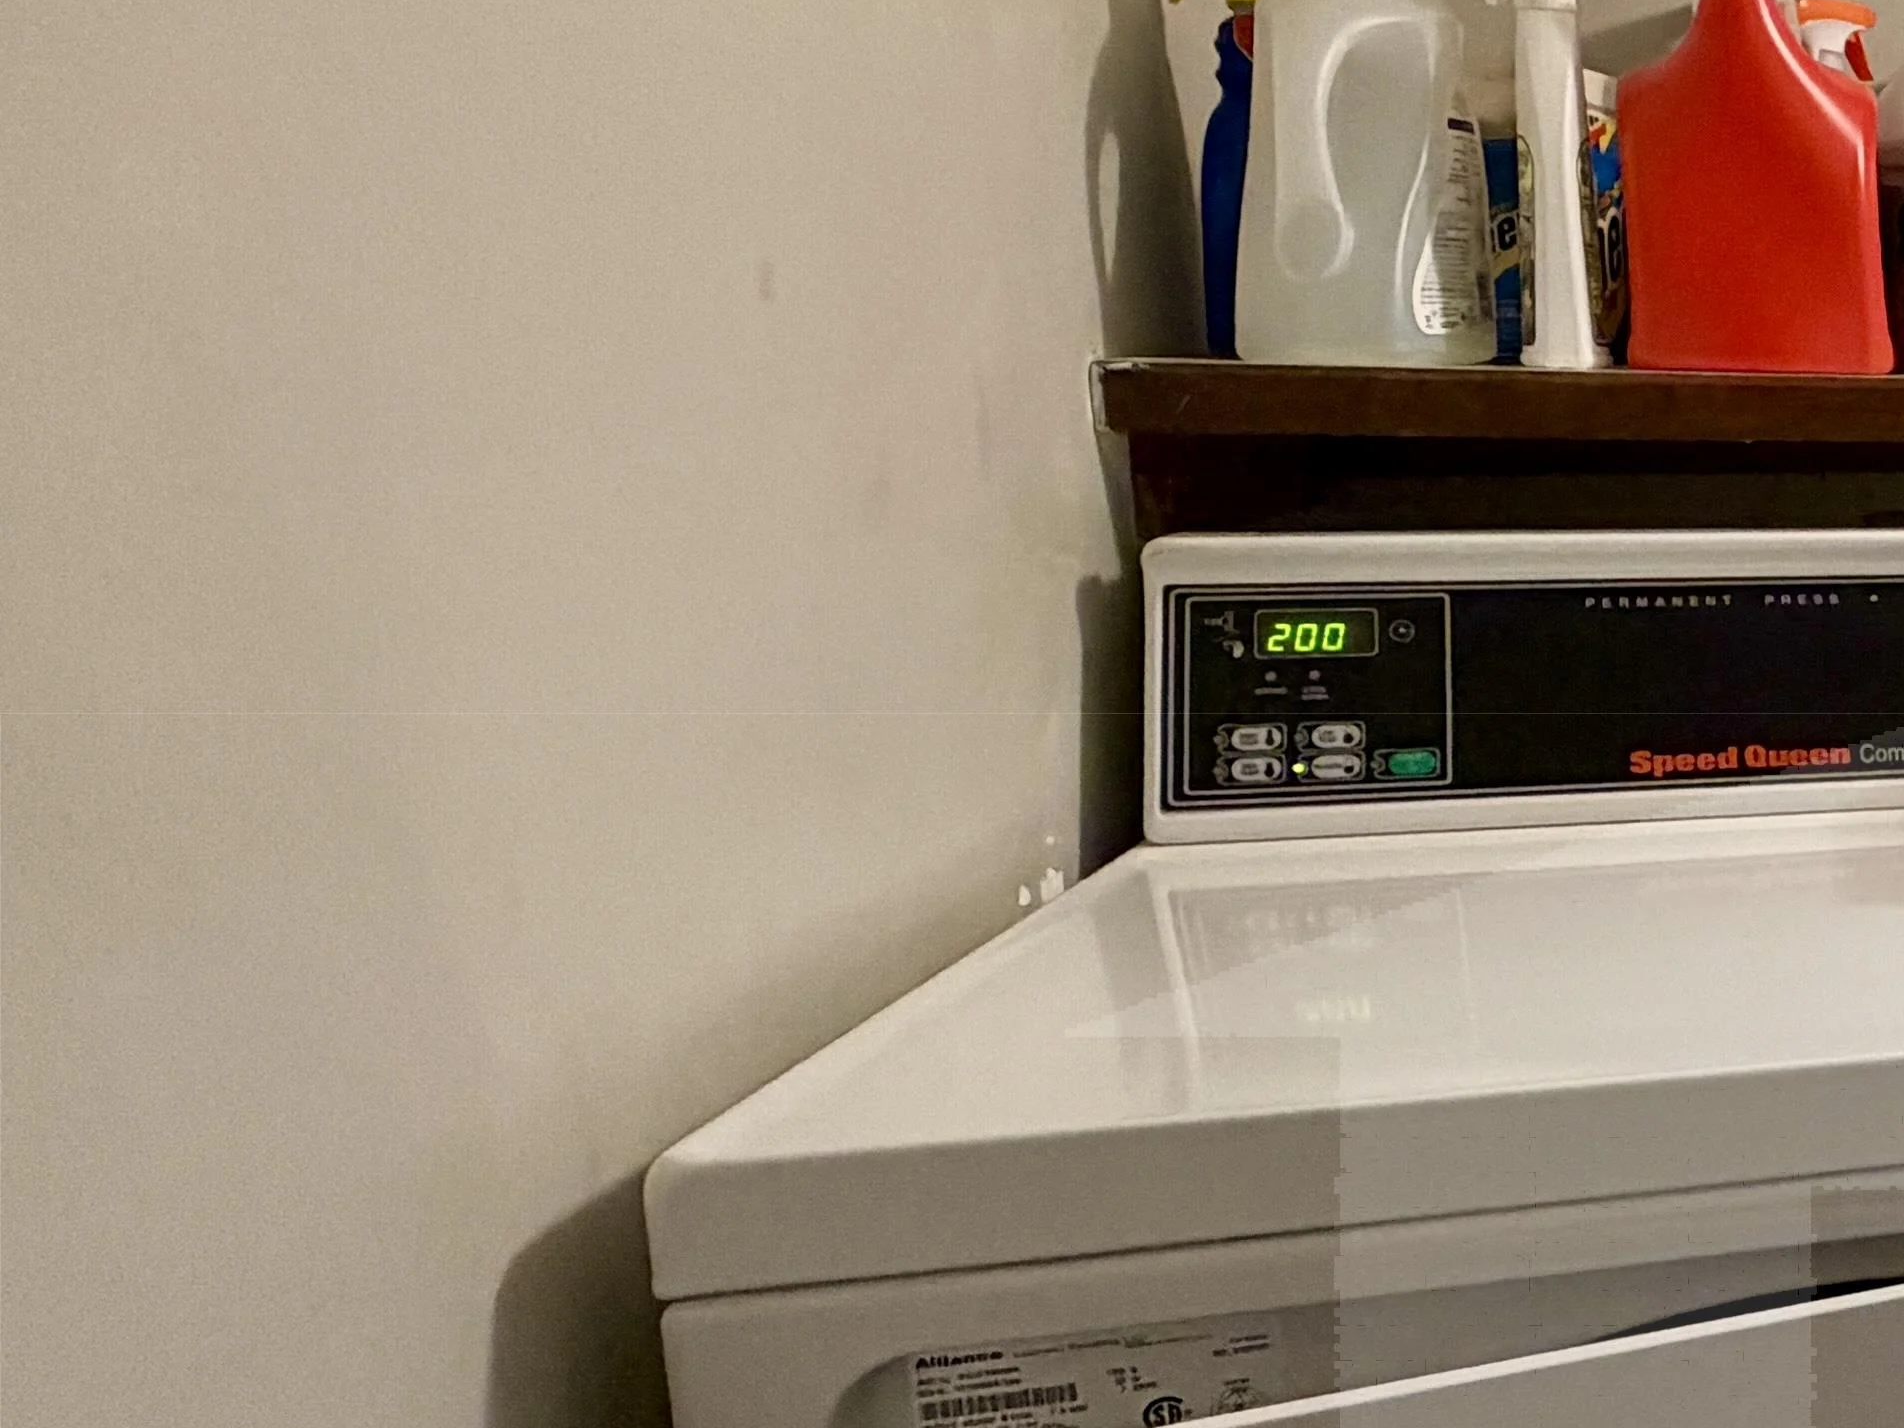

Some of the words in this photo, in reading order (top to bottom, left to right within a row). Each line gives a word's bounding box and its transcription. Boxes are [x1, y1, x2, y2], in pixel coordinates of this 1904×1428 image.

[1584, 593, 1732, 609] PERMANENT
[1764, 592, 1840, 606] PRESS
[1266, 622, 1346, 653] 200
[1629, 745, 1738, 778] Speed
[1743, 744, 1852, 768] Queen
[915, 1351, 1004, 1370] Alliance
